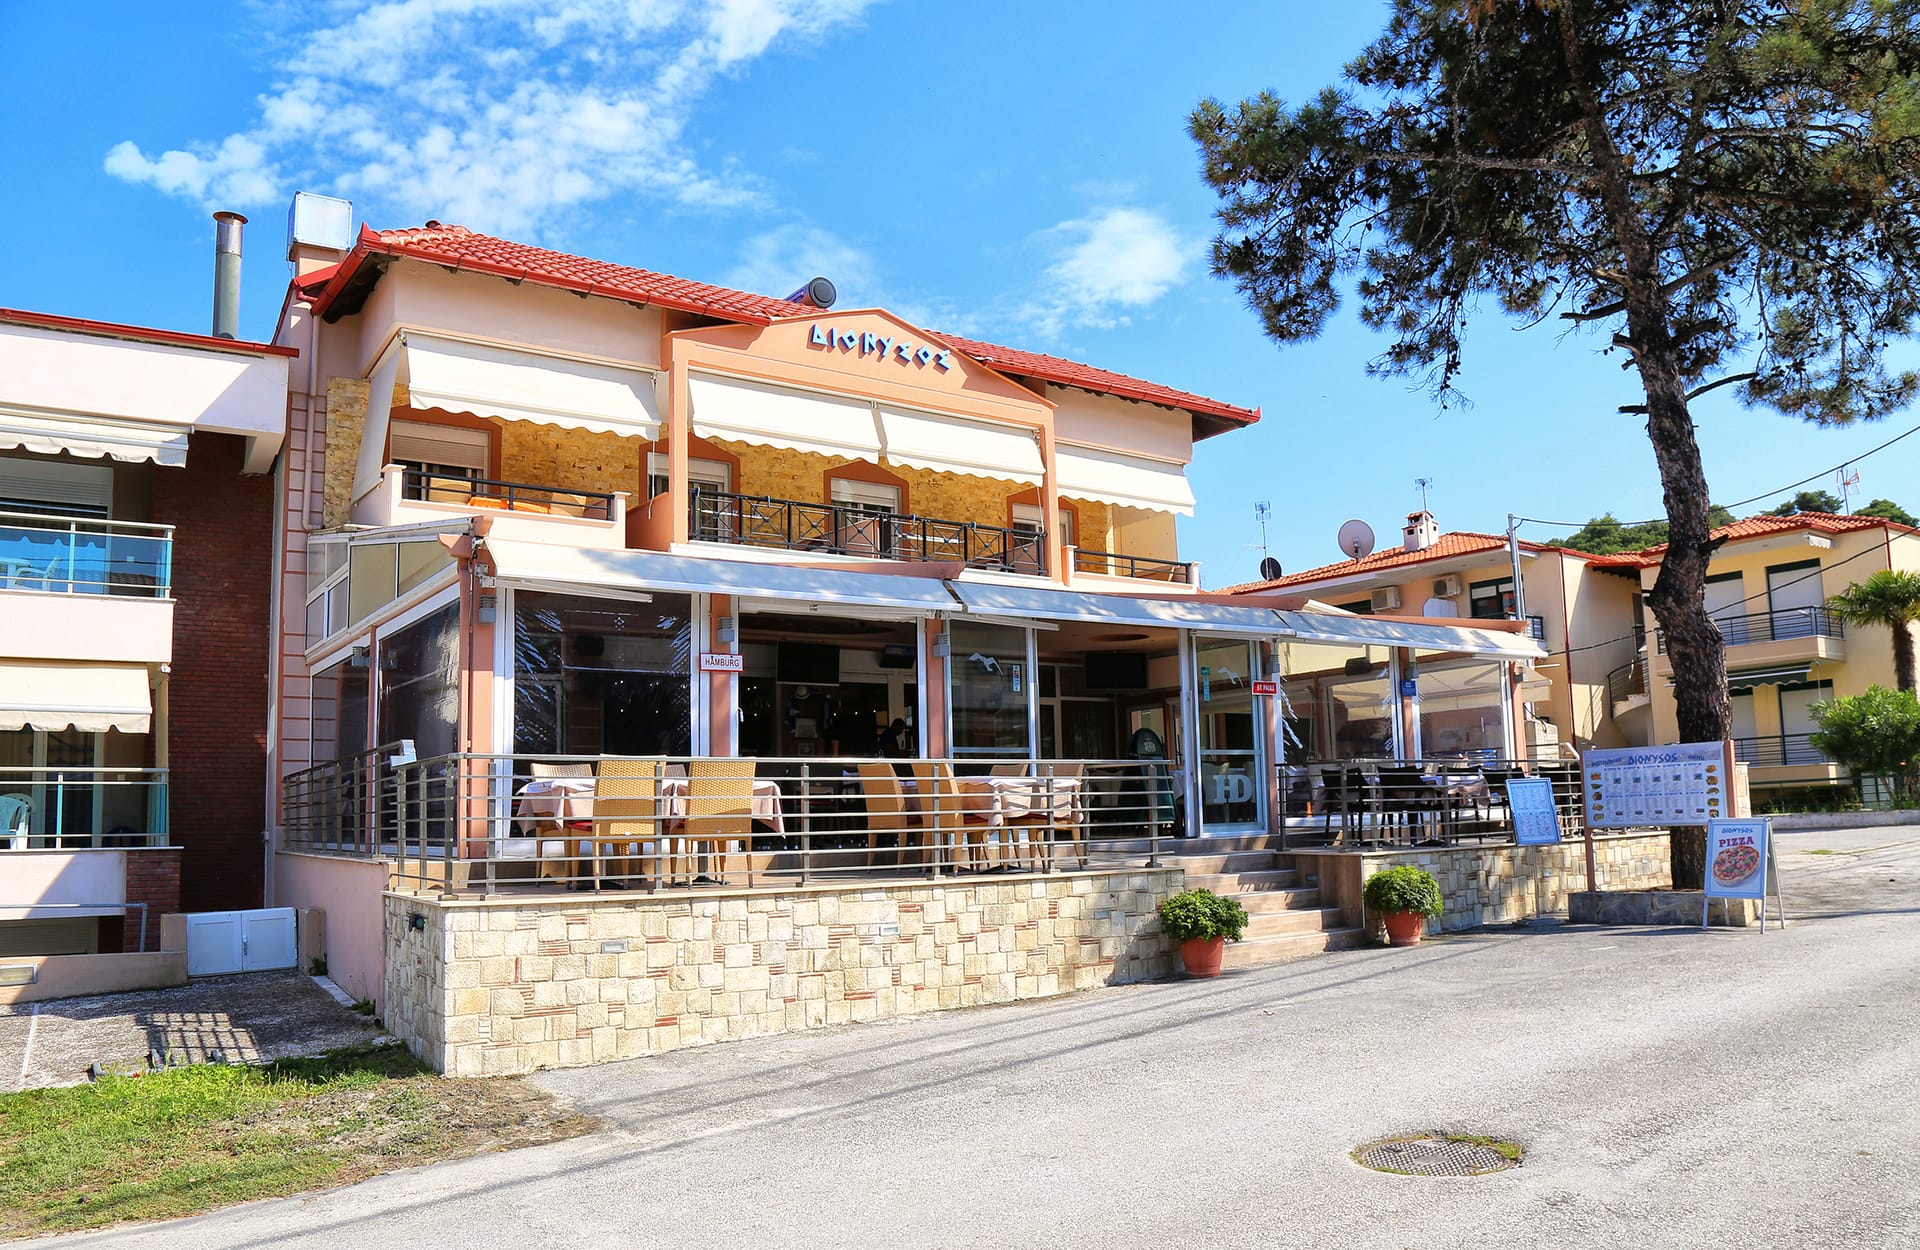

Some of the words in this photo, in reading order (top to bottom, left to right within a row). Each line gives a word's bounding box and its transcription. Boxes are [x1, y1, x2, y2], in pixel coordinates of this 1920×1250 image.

[705, 658, 739, 667] HAMBURG
[1213, 774, 1253, 803] HD
[1718, 836, 1755, 848] PIZZA
